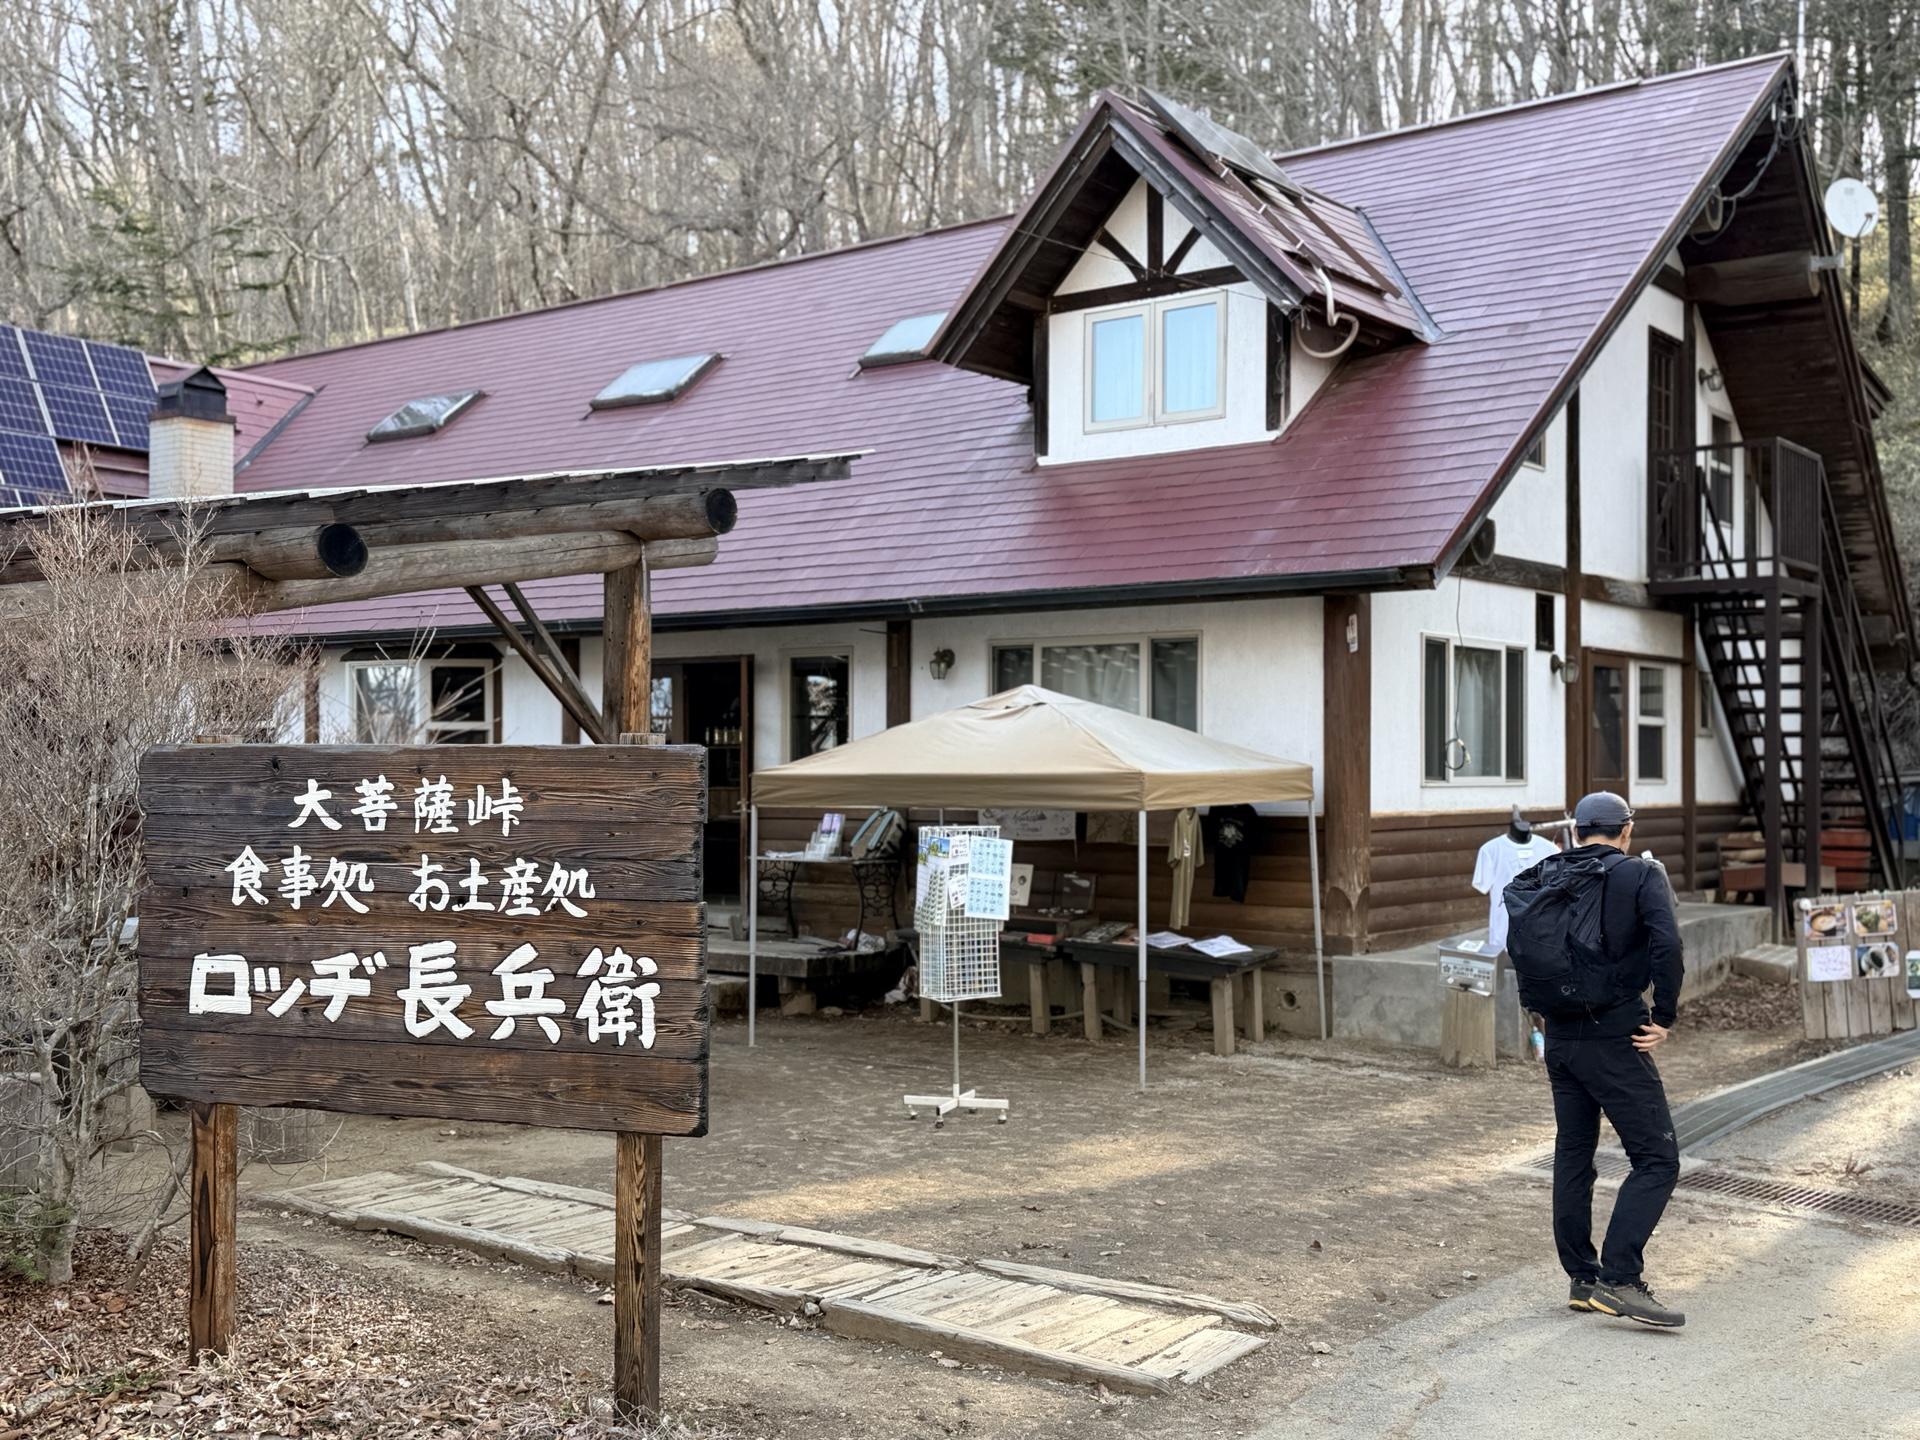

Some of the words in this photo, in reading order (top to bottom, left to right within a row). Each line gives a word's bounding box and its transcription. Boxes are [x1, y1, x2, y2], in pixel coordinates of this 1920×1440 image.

[287, 774, 525, 838] 大菩薩峠
[223, 844, 376, 914] 食事処
[407, 853, 597, 918] お土産処
